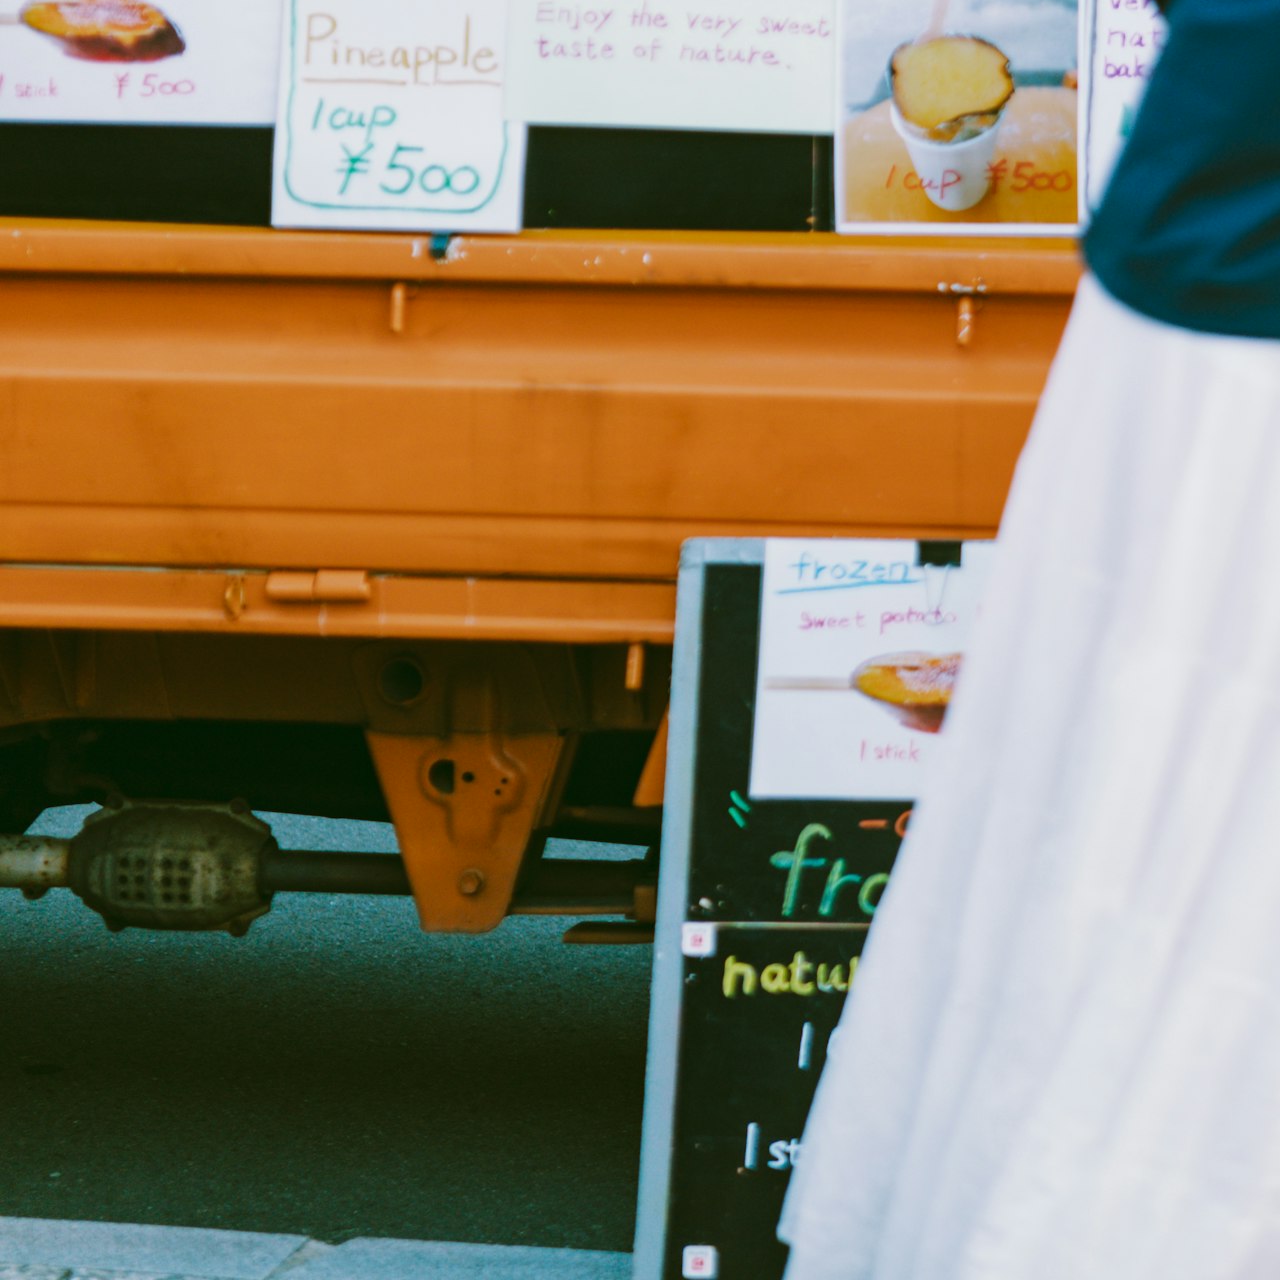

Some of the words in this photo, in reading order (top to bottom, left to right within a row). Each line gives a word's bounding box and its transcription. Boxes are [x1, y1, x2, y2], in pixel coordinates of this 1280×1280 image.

[535, 0, 614, 33] Enjoy
[630, 0, 669, 29] the
[686, 11, 742, 38] very
[756, 15, 832, 39] sweet
[304, 12, 500, 85] Pineapple
[536, 35, 615, 61] taste
[632, 38, 663, 62] of
[679, 42, 792, 70] nature.
[786, 551, 913, 584] frozen
[873, 738, 921, 763] stick
